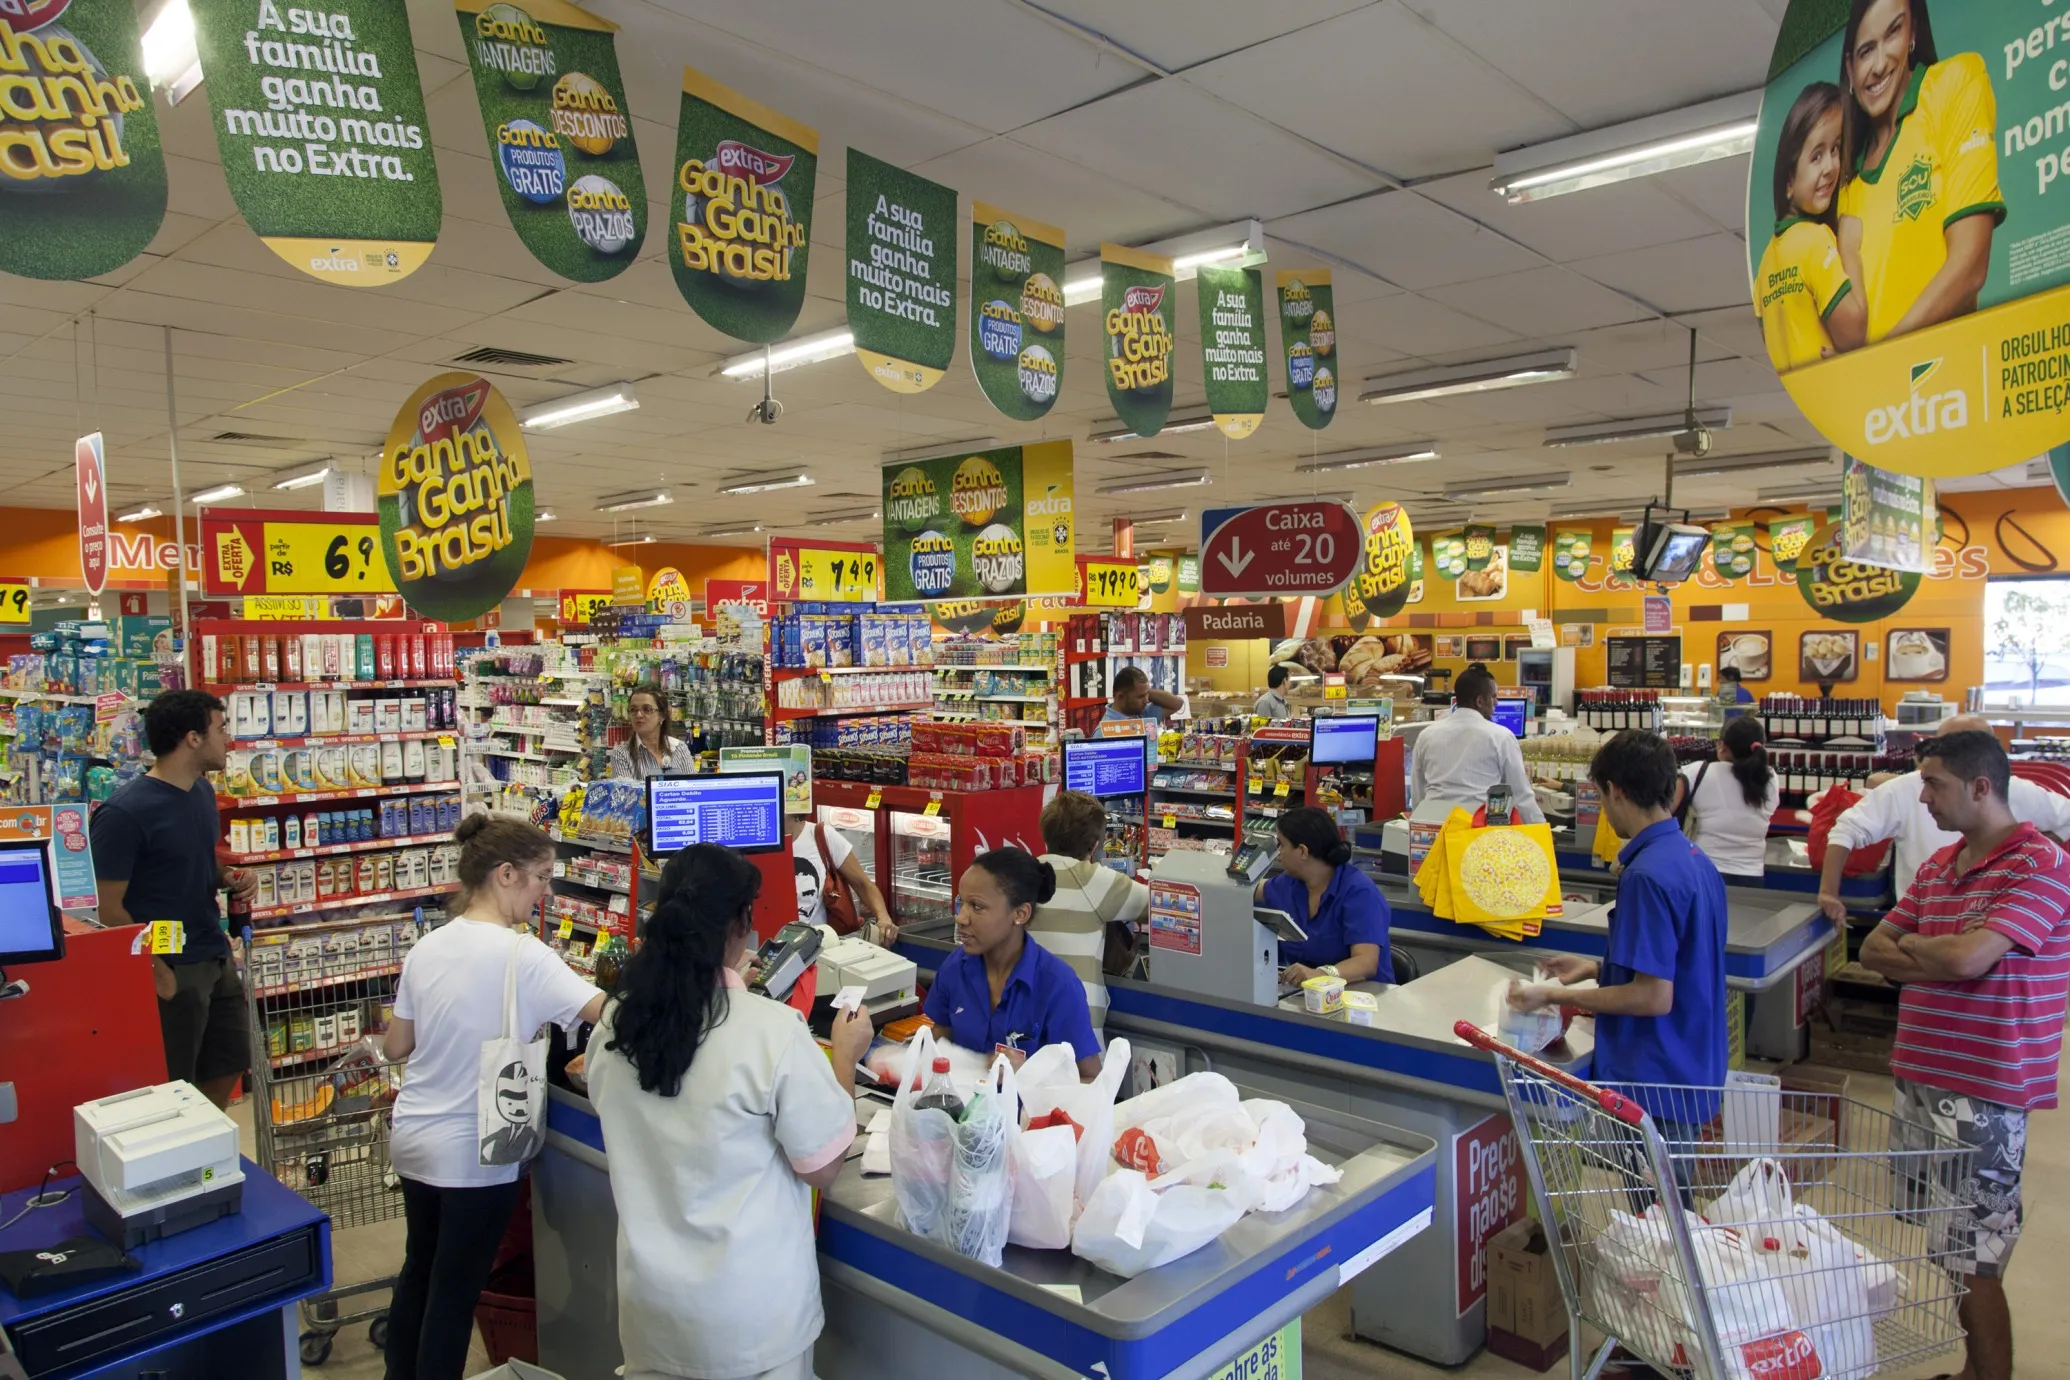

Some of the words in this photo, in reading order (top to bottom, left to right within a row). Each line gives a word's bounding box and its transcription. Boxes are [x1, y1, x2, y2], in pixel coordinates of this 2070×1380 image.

[258, 0, 284, 32] A
[290, 4, 355, 40] sua
[476, 14, 548, 45] Ganha
[244, 31, 382, 79] família
[473, 39, 556, 75] VANTAGENS
[0, 71, 145, 121] anha
[261, 77, 383, 112] ganha
[552, 84, 618, 112] Ganha
[225, 106, 337, 142] muito
[342, 118, 423, 150] mais
[497, 124, 560, 148] Ganha
[551, 109, 628, 139] DESCONTOS
[0, 114, 131, 180] asil
[511, 149, 555, 166] PRODUTOS
[720, 146, 765, 174] extra
[254, 145, 302, 174] no
[308, 144, 414, 182] Extra.
[510, 167, 563, 195] GRÁTIS
[680, 159, 788, 216] Ganha
[1901, 171, 1928, 195] SOU
[567, 187, 631, 210] Ganha
[875, 194, 888, 217] A
[891, 202, 923, 230] sua
[575, 210, 634, 241] PRAZOS
[706, 198, 806, 248] Ganha
[868, 213, 934, 257] família
[678, 222, 791, 281] Brasil
[985, 227, 1027, 252] Ganha
[310, 255, 358, 272] extra
[870, 243, 930, 279] ganha
[979, 243, 1031, 274] VANTAGENS
[851, 258, 902, 292] muito
[905, 276, 950, 308] mais
[1768, 265, 1798, 287] Bruna
[1023, 279, 1061, 302] Ganha
[1127, 290, 1150, 308] extra
[1217, 290, 1225, 307] A
[1227, 293, 1246, 308] sua
[1762, 281, 1804, 308] Brasileiro
[860, 286, 882, 309] no
[885, 293, 940, 327] Extra.
[979, 301, 1021, 323] Ganha
[1020, 295, 1064, 324] DESCONTOS
[1212, 309, 1252, 328] família
[988, 319, 1017, 333] PRODUTOS
[1106, 307, 1165, 335] Ganha
[984, 332, 1018, 356] GRÁTIS
[1124, 332, 1173, 362] Ganha
[1216, 329, 1251, 346] ganha
[1018, 352, 1056, 373] Ganha
[1205, 347, 1237, 363] muito
[1238, 347, 1263, 363] mais
[1020, 370, 1056, 396] PRAZOS
[1109, 353, 1168, 391] Brasil
[1213, 366, 1227, 381] no
[1228, 364, 1259, 381] Extra.
[422, 396, 466, 433] extra
[1865, 390, 1967, 445] extra
[2003, 396, 2012, 418] A
[392, 425, 498, 490] Ganha
[418, 453, 522, 529] Ganha
[891, 479, 935, 496] Ganha
[953, 469, 1002, 488] Ganha
[886, 495, 940, 521] VANTAGENS
[950, 486, 1007, 513] DESCONTOS
[1027, 496, 1071, 517] extra
[82, 523, 104, 538] Consulte
[1265, 509, 1325, 532] Caixa
[1372, 512, 1391, 530] extra
[89, 542, 103, 556] preço
[394, 499, 512, 582] Brasil
[911, 536, 953, 553] Ganha
[972, 536, 1022, 555] Ganha
[1271, 538, 1291, 551] até
[1294, 533, 1334, 564] 20
[1366, 525, 1400, 553] anha
[89, 558, 100, 570] aqui
[222, 544, 231, 571] EXTRA
[230, 538, 244, 578] OFERTA
[272, 561, 293, 576] R$
[918, 553, 948, 566] PRODUTOS
[974, 554, 1023, 581] PRAZOS
[1369, 540, 1414, 574] Ganha
[802, 577, 813, 588] R$
[915, 568, 951, 590] GRÁTIS
[1089, 573, 1096, 582] R$
[1265, 571, 1334, 586] volumes
[1359, 560, 1406, 599] Brasil
[1809, 570, 1903, 606] Brasil
[1202, 611, 1264, 630] Padaria
[36, 815, 47, 826] br
[244, 854, 266, 862] OFERTA
[252, 910, 272, 918] OFERTA
[204, 1169, 214, 1180] 5
[1469, 1128, 1517, 1194] Preço
[1470, 1181, 1499, 1242] não
[1500, 1174, 1517, 1218] se
[1262, 1336, 1277, 1359] as
